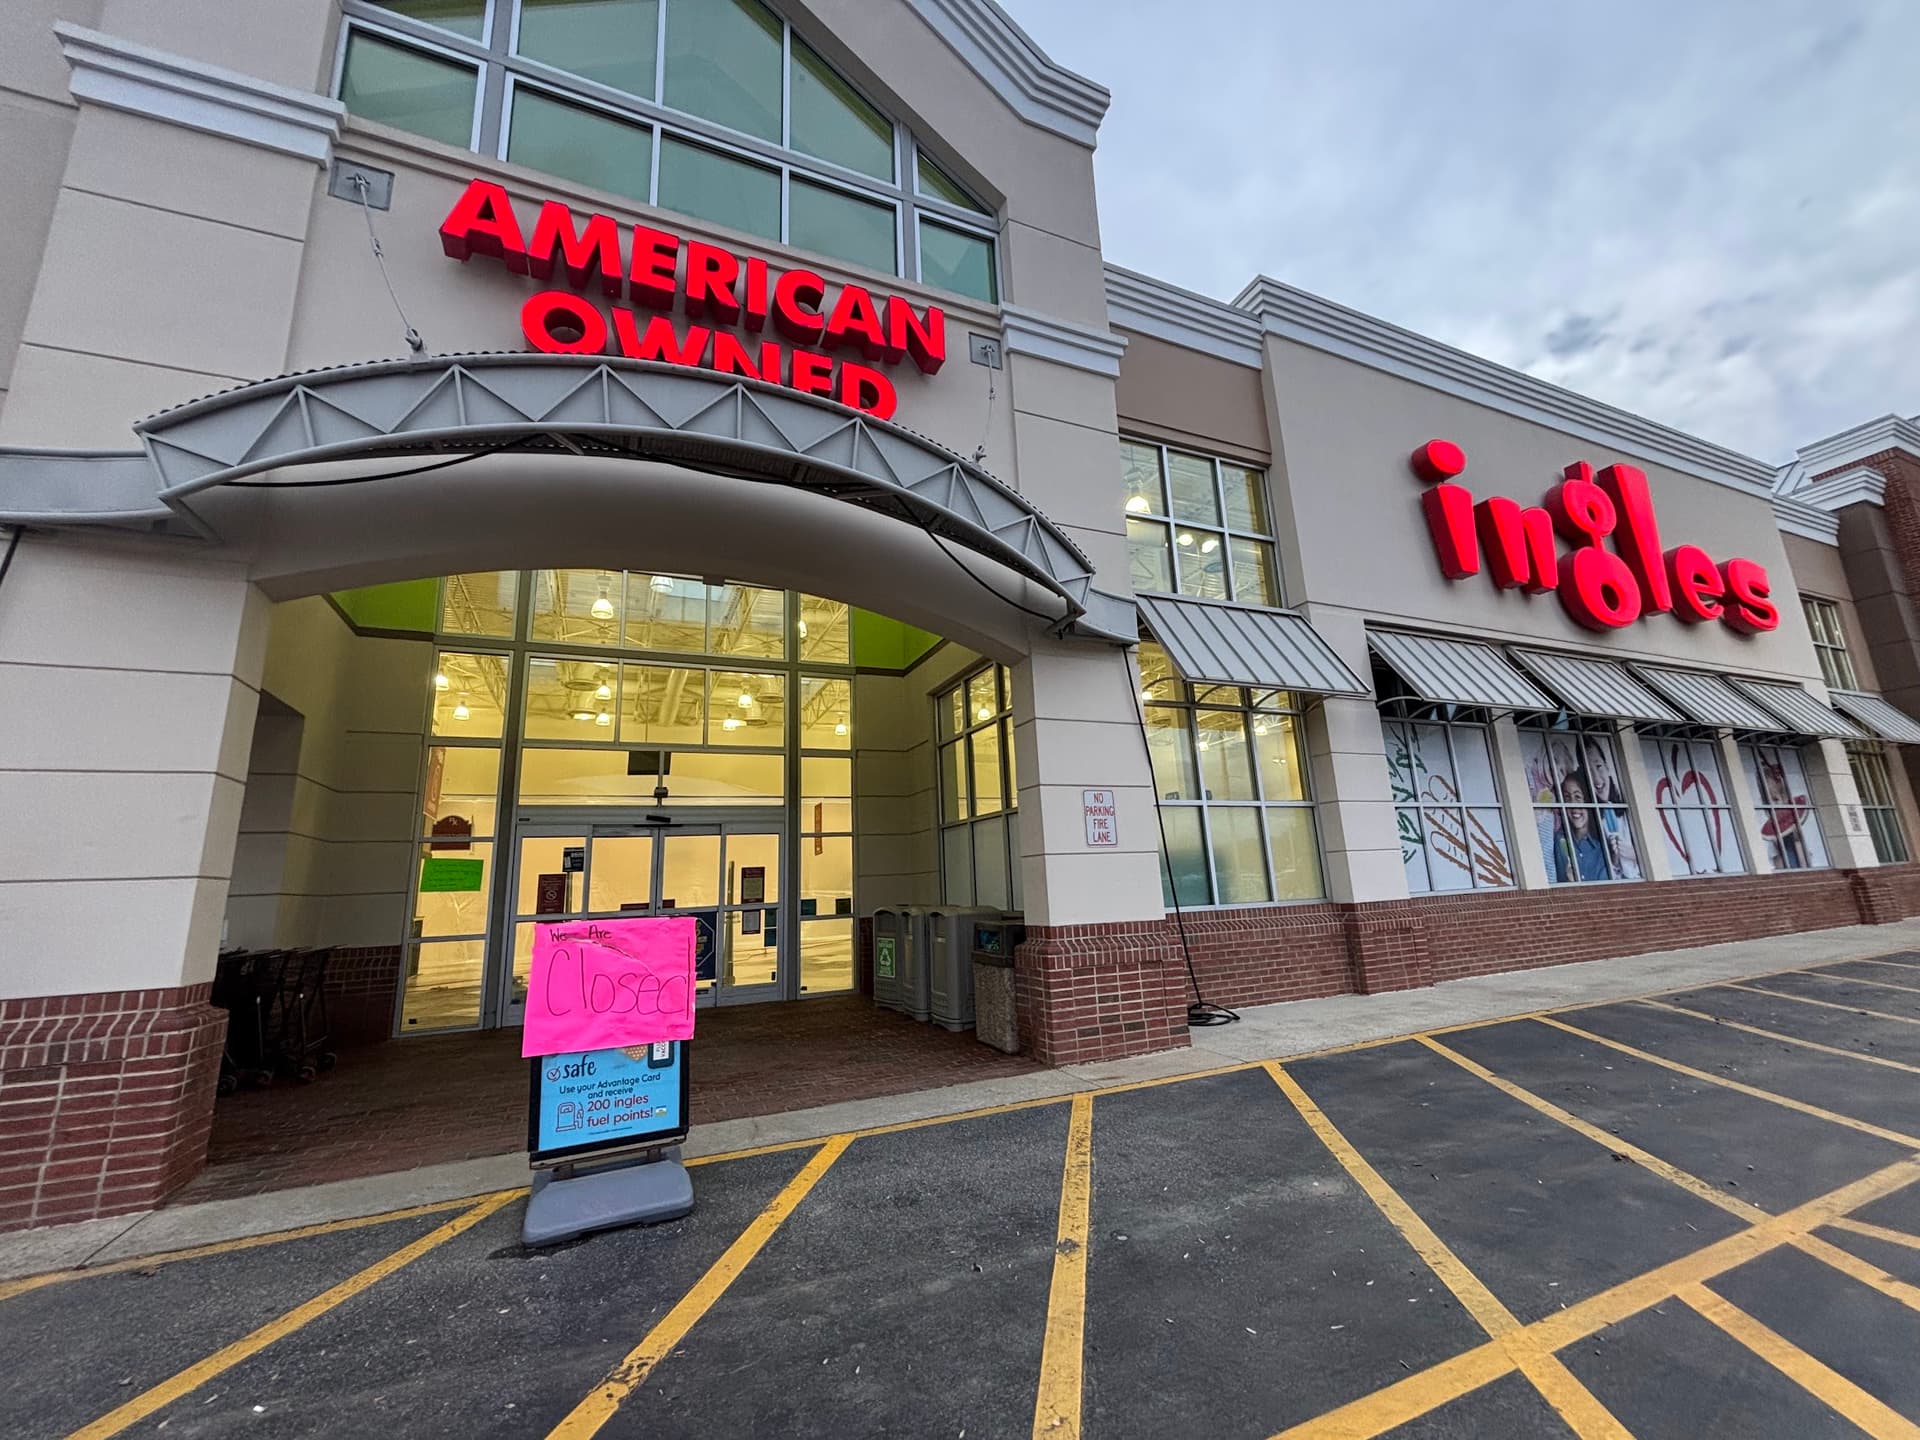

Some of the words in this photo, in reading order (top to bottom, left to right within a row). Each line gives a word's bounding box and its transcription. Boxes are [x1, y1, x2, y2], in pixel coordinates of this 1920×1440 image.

[439, 178, 945, 375] AMERICAN
[521, 290, 897, 420] OWNED
[1411, 439, 1780, 633] ingles
[1093, 793, 1104, 804] NO
[1085, 805, 1115, 817] PARKING
[1093, 818, 1109, 829] FIRE
[1093, 831, 1111, 843] LANE
[550, 928, 567, 942] We
[588, 924, 612, 939] Are
[546, 936, 691, 1020] Closed
[562, 1054, 597, 1079] safe
[559, 1085, 576, 1095] Use
[576, 1083, 595, 1095] your
[597, 1077, 640, 1090] Advantage
[641, 1072, 661, 1083] Card
[587, 1090, 603, 1100] and
[605, 1087, 634, 1097] receive
[587, 1098, 611, 1112] 200
[614, 1094, 649, 1109] ingles
[587, 1114, 610, 1127] fuel
[613, 1106, 654, 1126] points!
